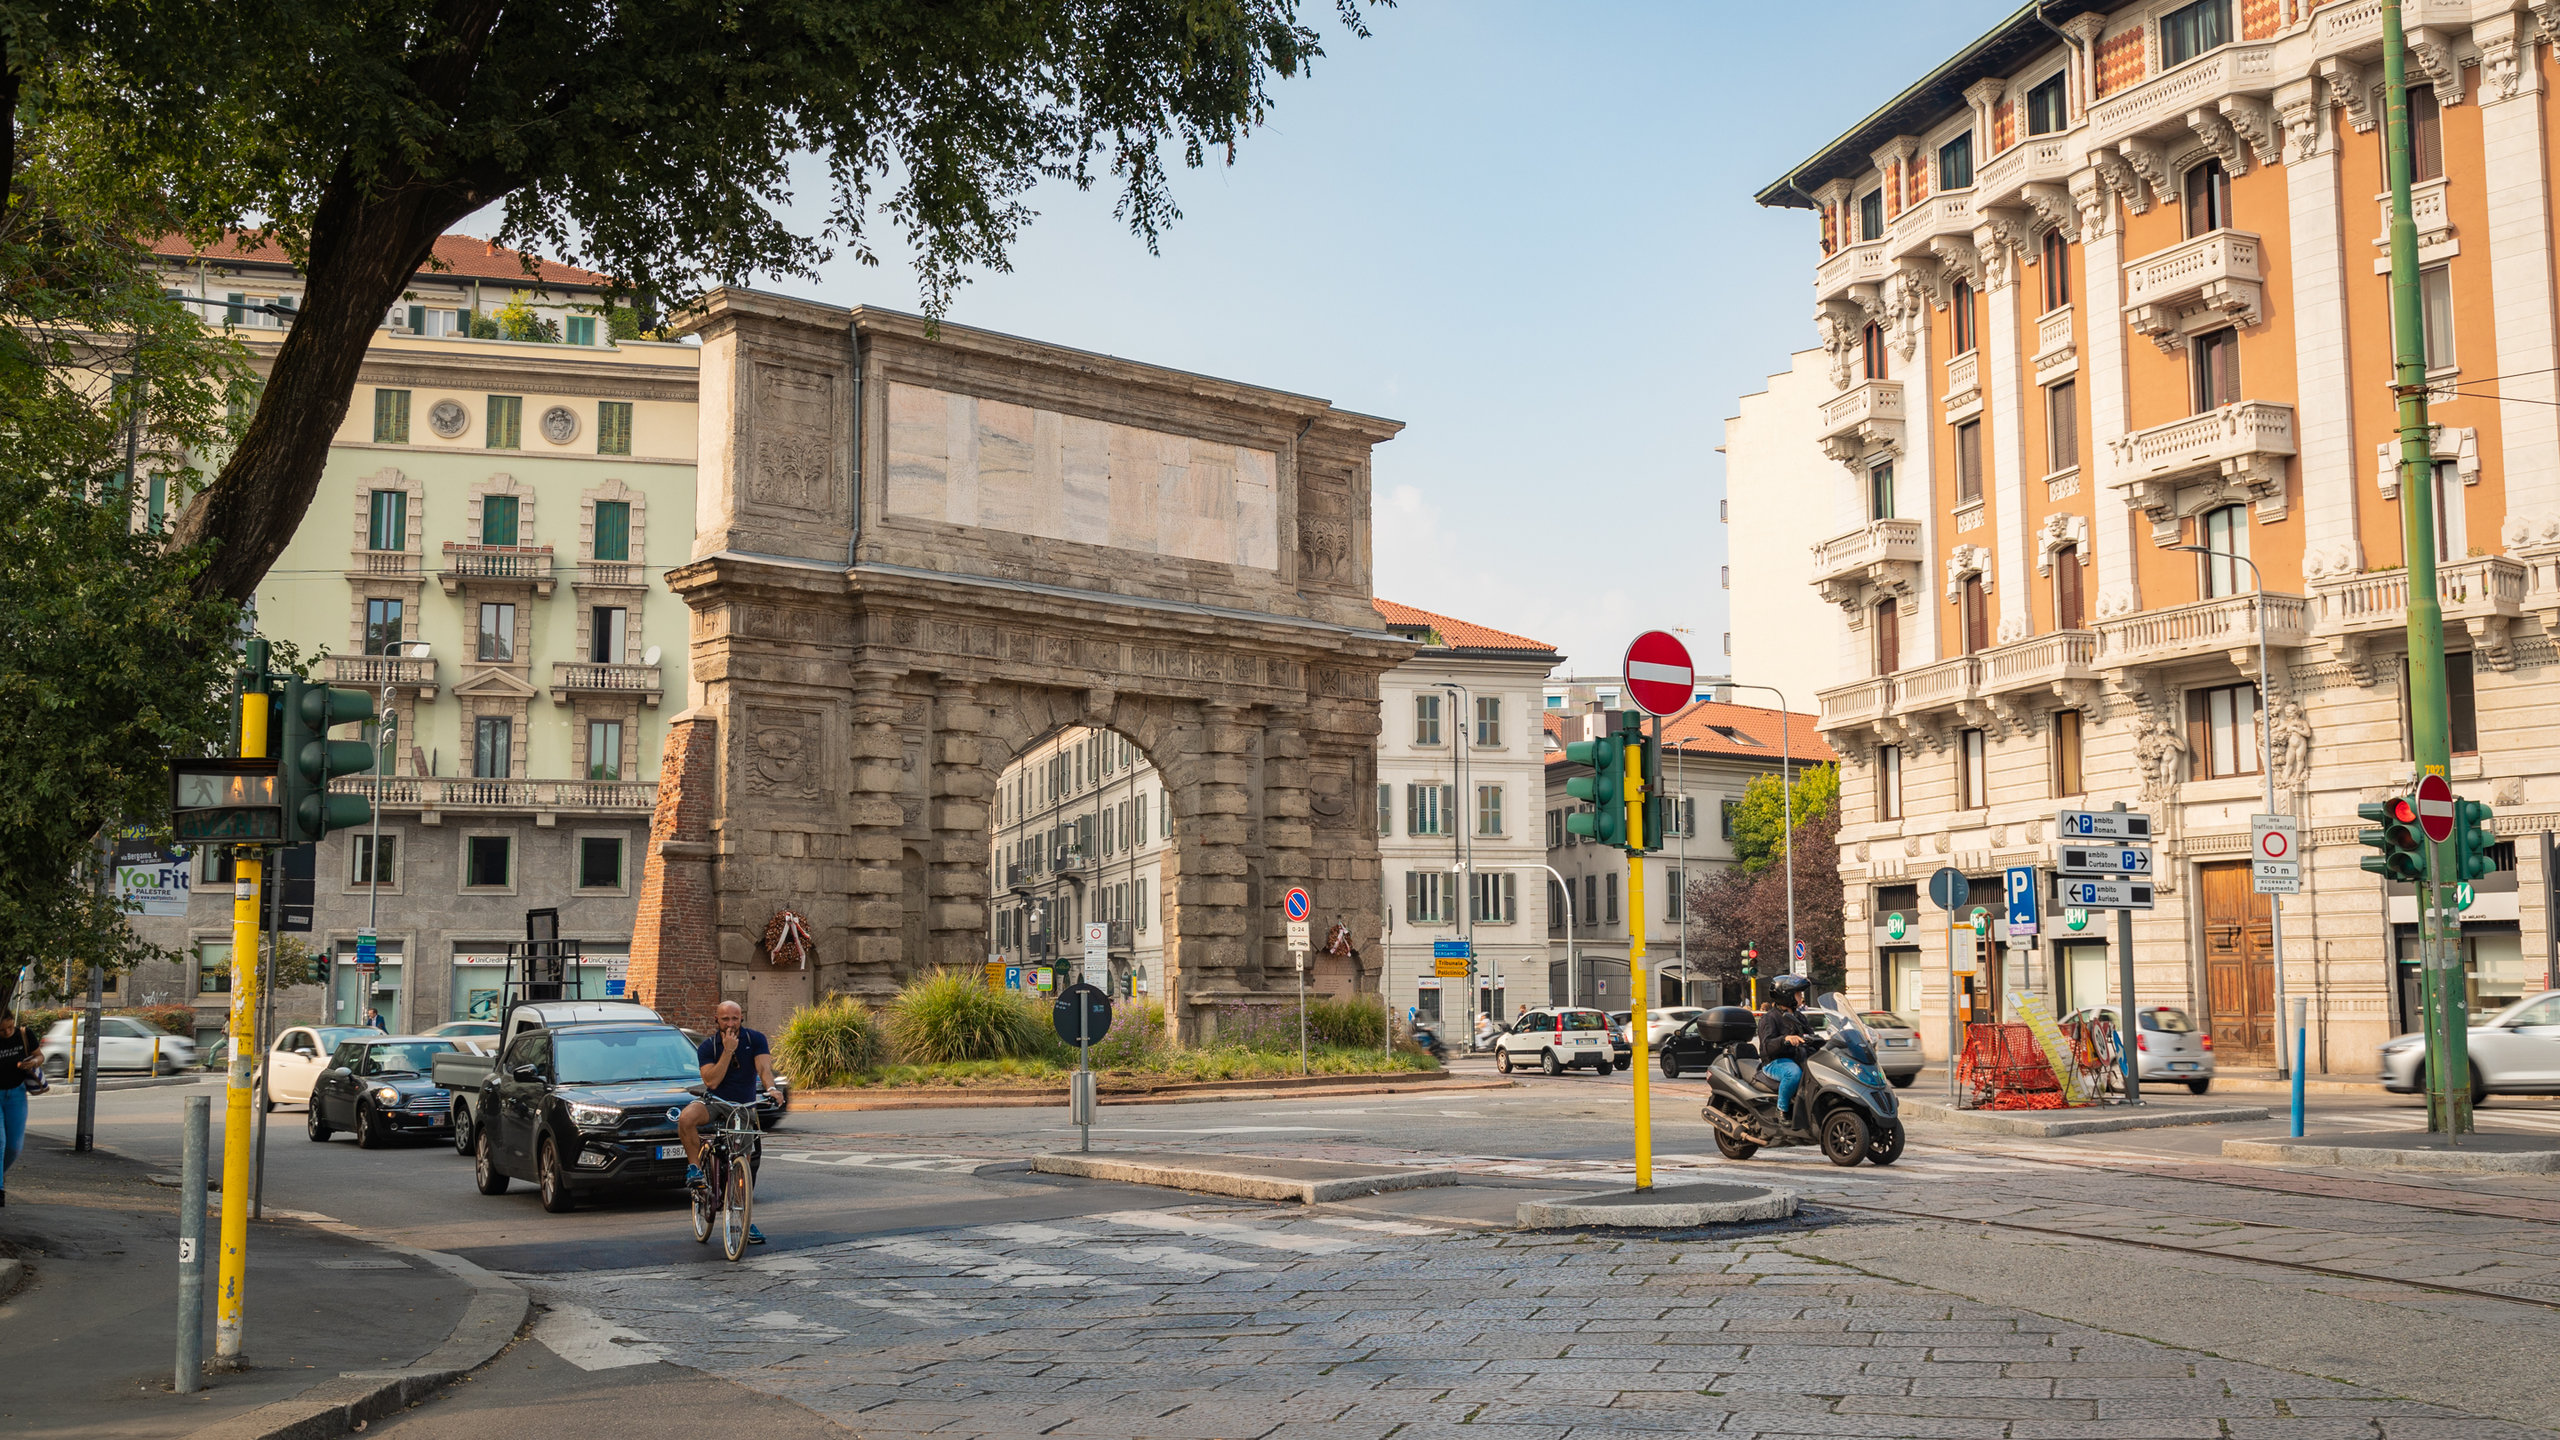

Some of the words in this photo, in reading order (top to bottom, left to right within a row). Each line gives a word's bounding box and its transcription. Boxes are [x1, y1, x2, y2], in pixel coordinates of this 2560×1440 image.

[2424, 764, 2446, 777] 7923
[2082, 817, 2091, 832] P
[2094, 826, 2117, 834] Romana
[129, 824, 146, 840] 29
[153, 851, 158, 859] 4
[2125, 854, 2133, 867] P
[2263, 866, 2276, 874] 50
[2281, 867, 2290, 875] m
[117, 867, 189, 889] YouFit
[136, 888, 171, 896] PALESTRE
[2011, 871, 2028, 904] P
[2085, 886, 2093, 900] P
[2097, 895, 2119, 903] Aurispa
[2065, 908, 2087, 924] BPM
[1887, 918, 1905, 933] BPM
[1008, 969, 1017, 980] P
